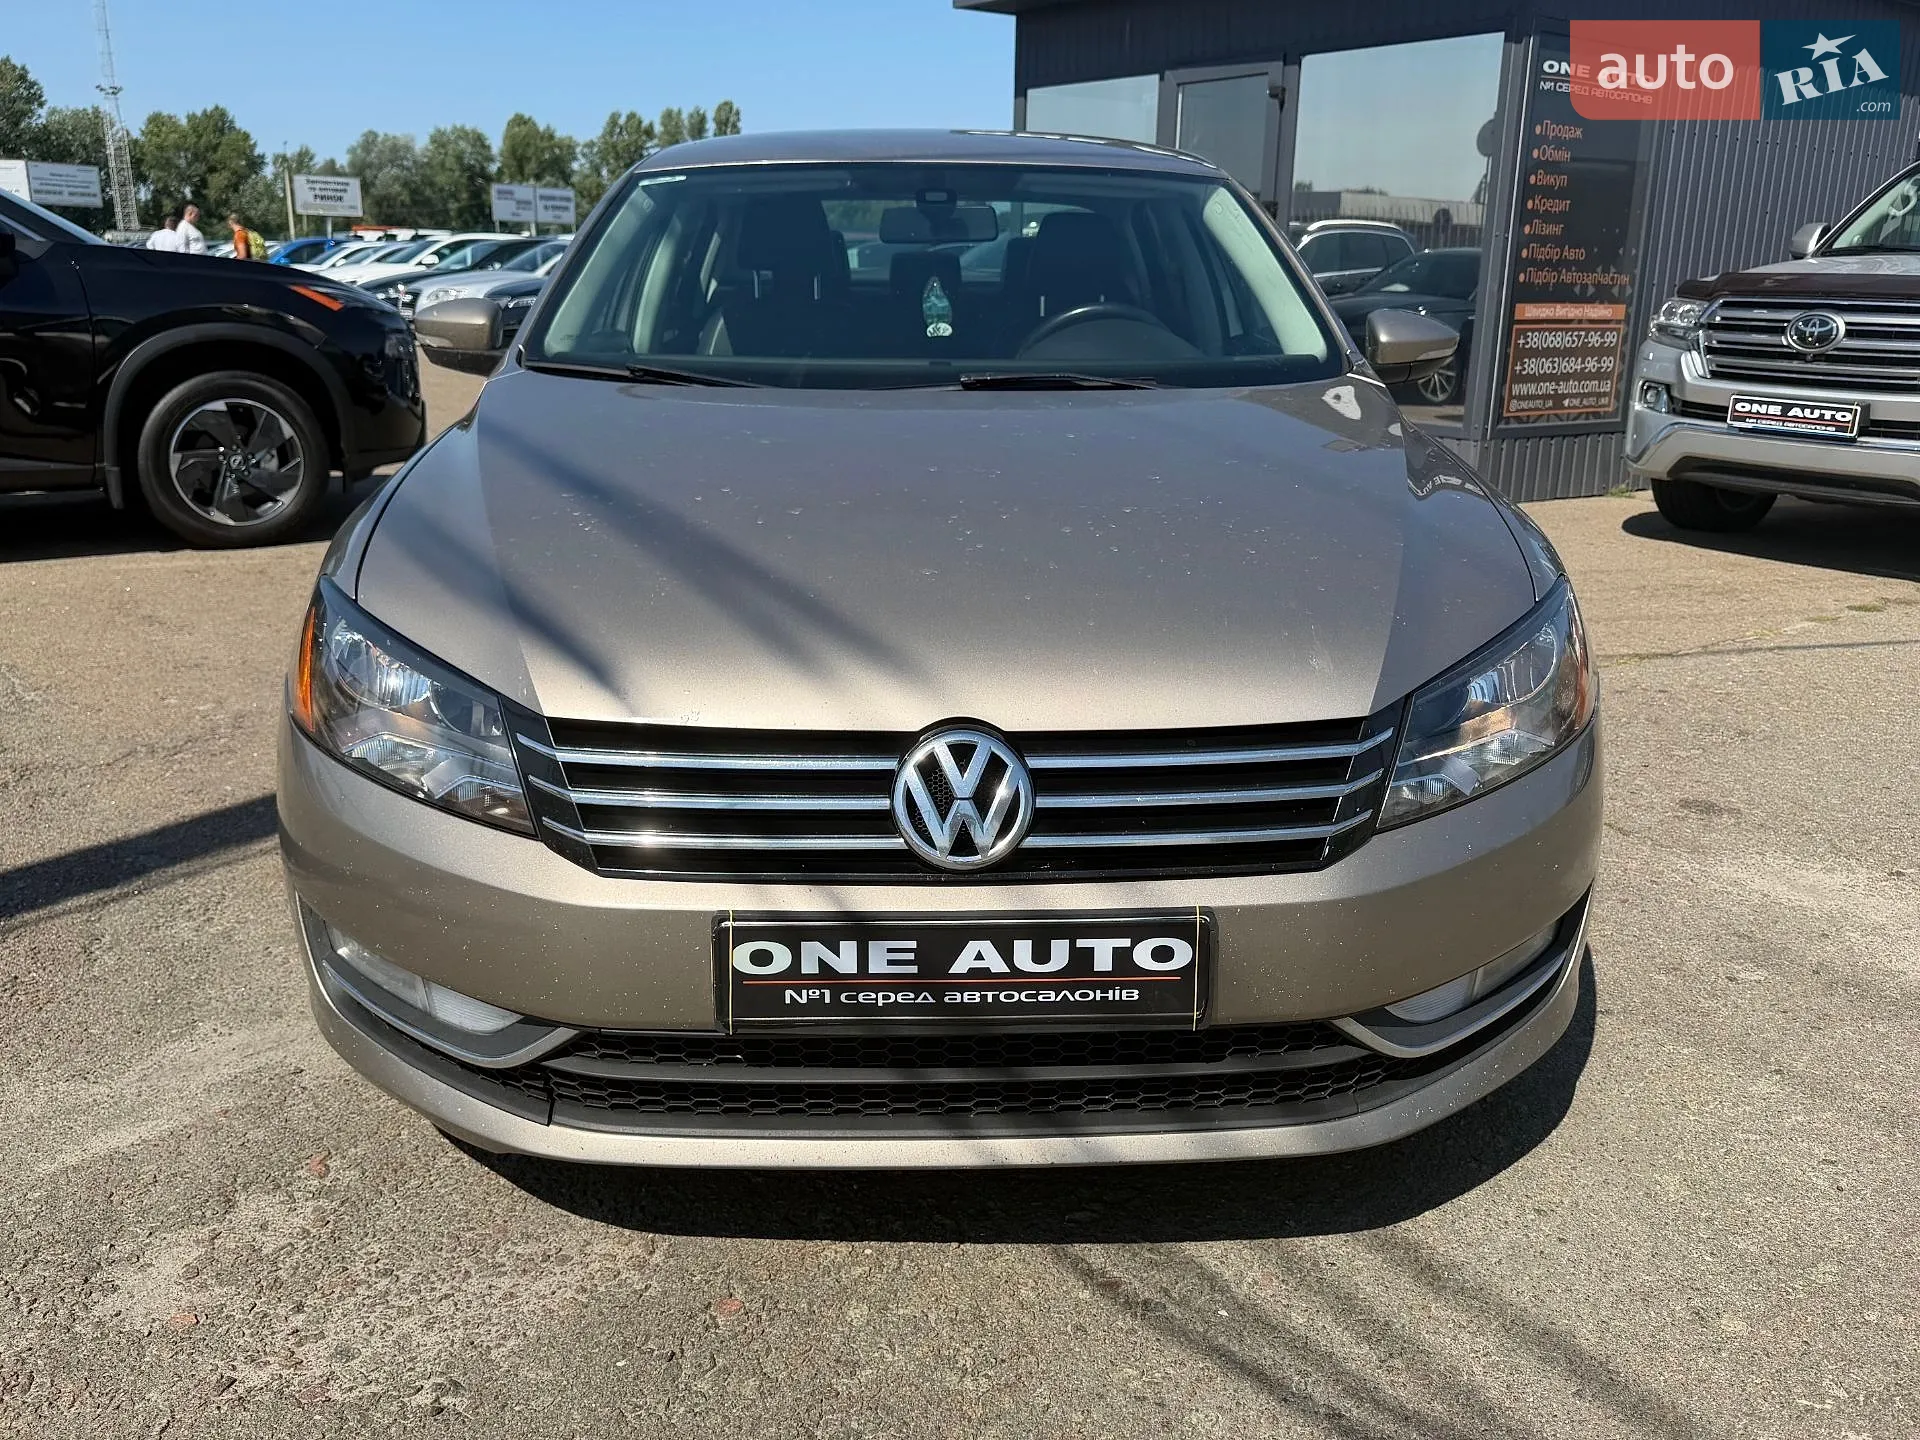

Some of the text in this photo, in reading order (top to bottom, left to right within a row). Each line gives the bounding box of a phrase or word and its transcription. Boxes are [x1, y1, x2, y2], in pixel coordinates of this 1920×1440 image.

[1542, 60, 1590, 77] ONE
[1542, 120, 1583, 140] Продаж
[1539, 144, 1571, 162] Обмін
[1536, 169, 1568, 190] Викуп
[1534, 194, 1571, 213] Кредит
[1530, 219, 1564, 236] Лізинг
[1528, 243, 1586, 262] Підбір Авто
[1525, 267, 1630, 286] Підбір Автозапчастин
[1517, 331, 1617, 350] +38(068)657-96-99
[1514, 356, 1614, 376] +38(063)684-96-99
[1511, 378, 1610, 396] www.one-auto.com.ua
[1735, 402, 1852, 422] ONE AUTO
[732, 937, 1193, 975] ONE AUTO
[784, 987, 831, 1004] №1
